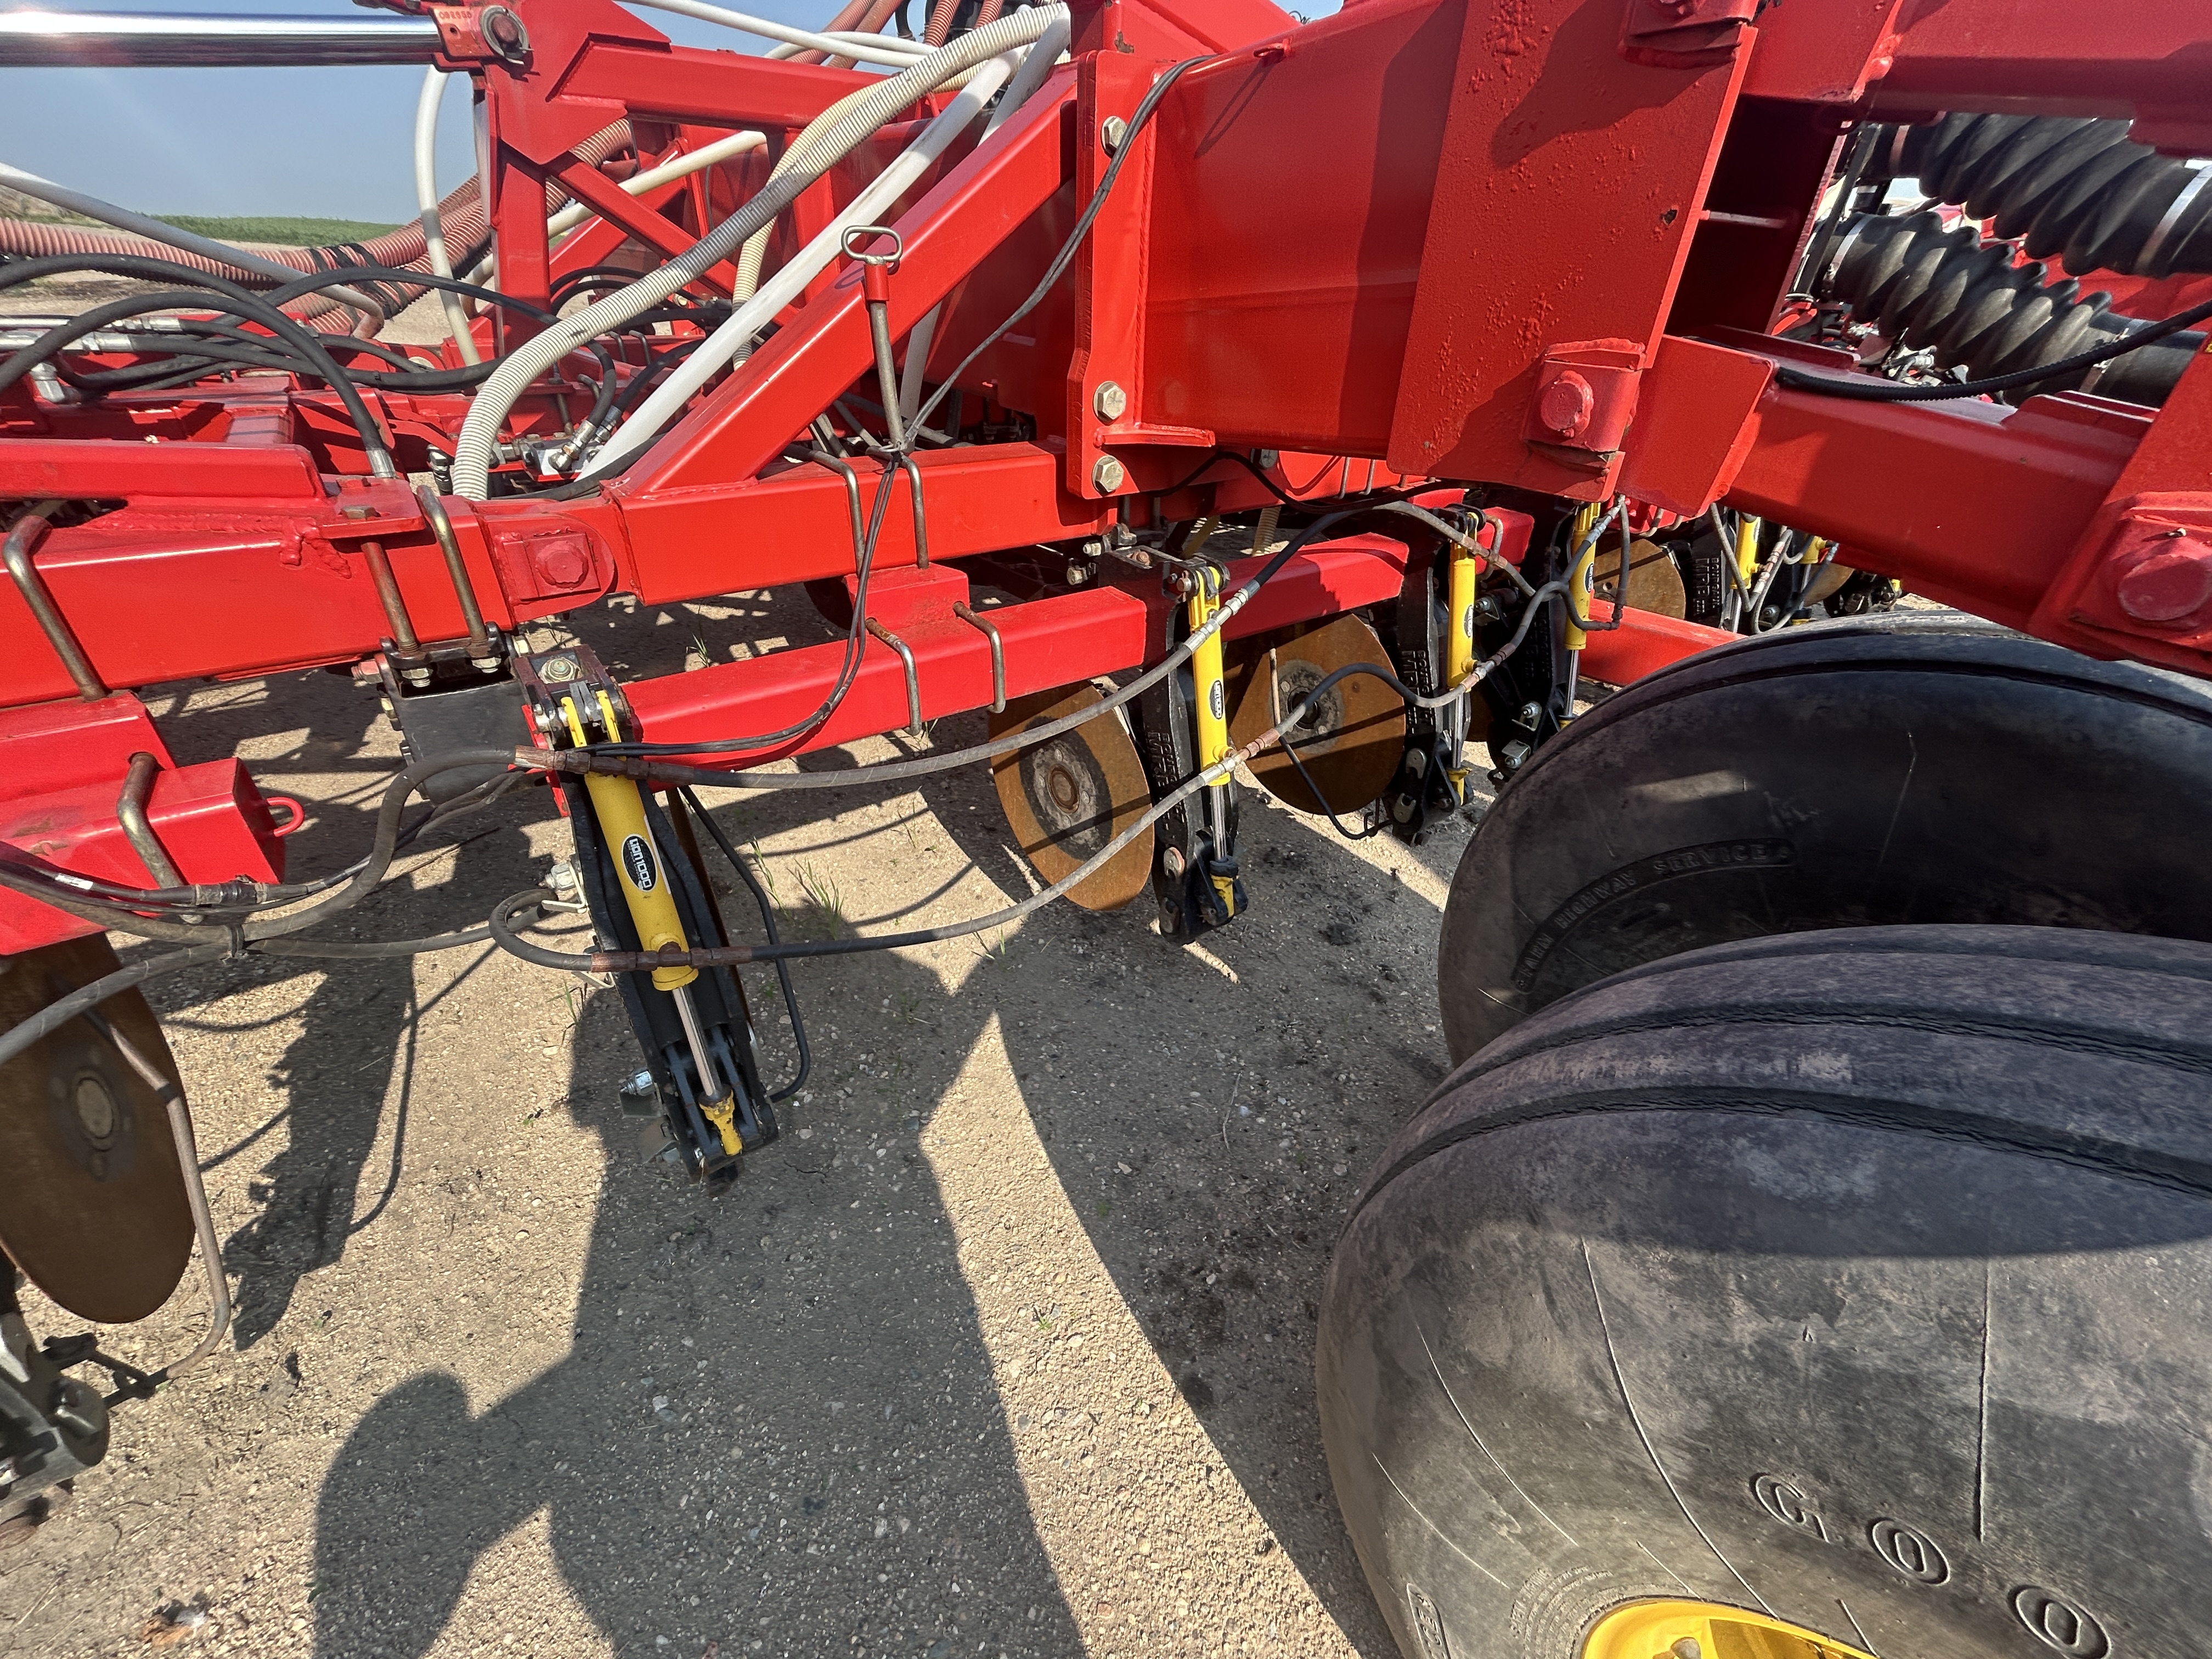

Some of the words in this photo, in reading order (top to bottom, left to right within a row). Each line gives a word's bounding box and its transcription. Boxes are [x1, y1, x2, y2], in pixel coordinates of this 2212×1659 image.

[1521, 934, 1554, 978] FARM
[1554, 872, 1636, 929] HIGHWAY
[1653, 844, 1769, 873] SERVICE
